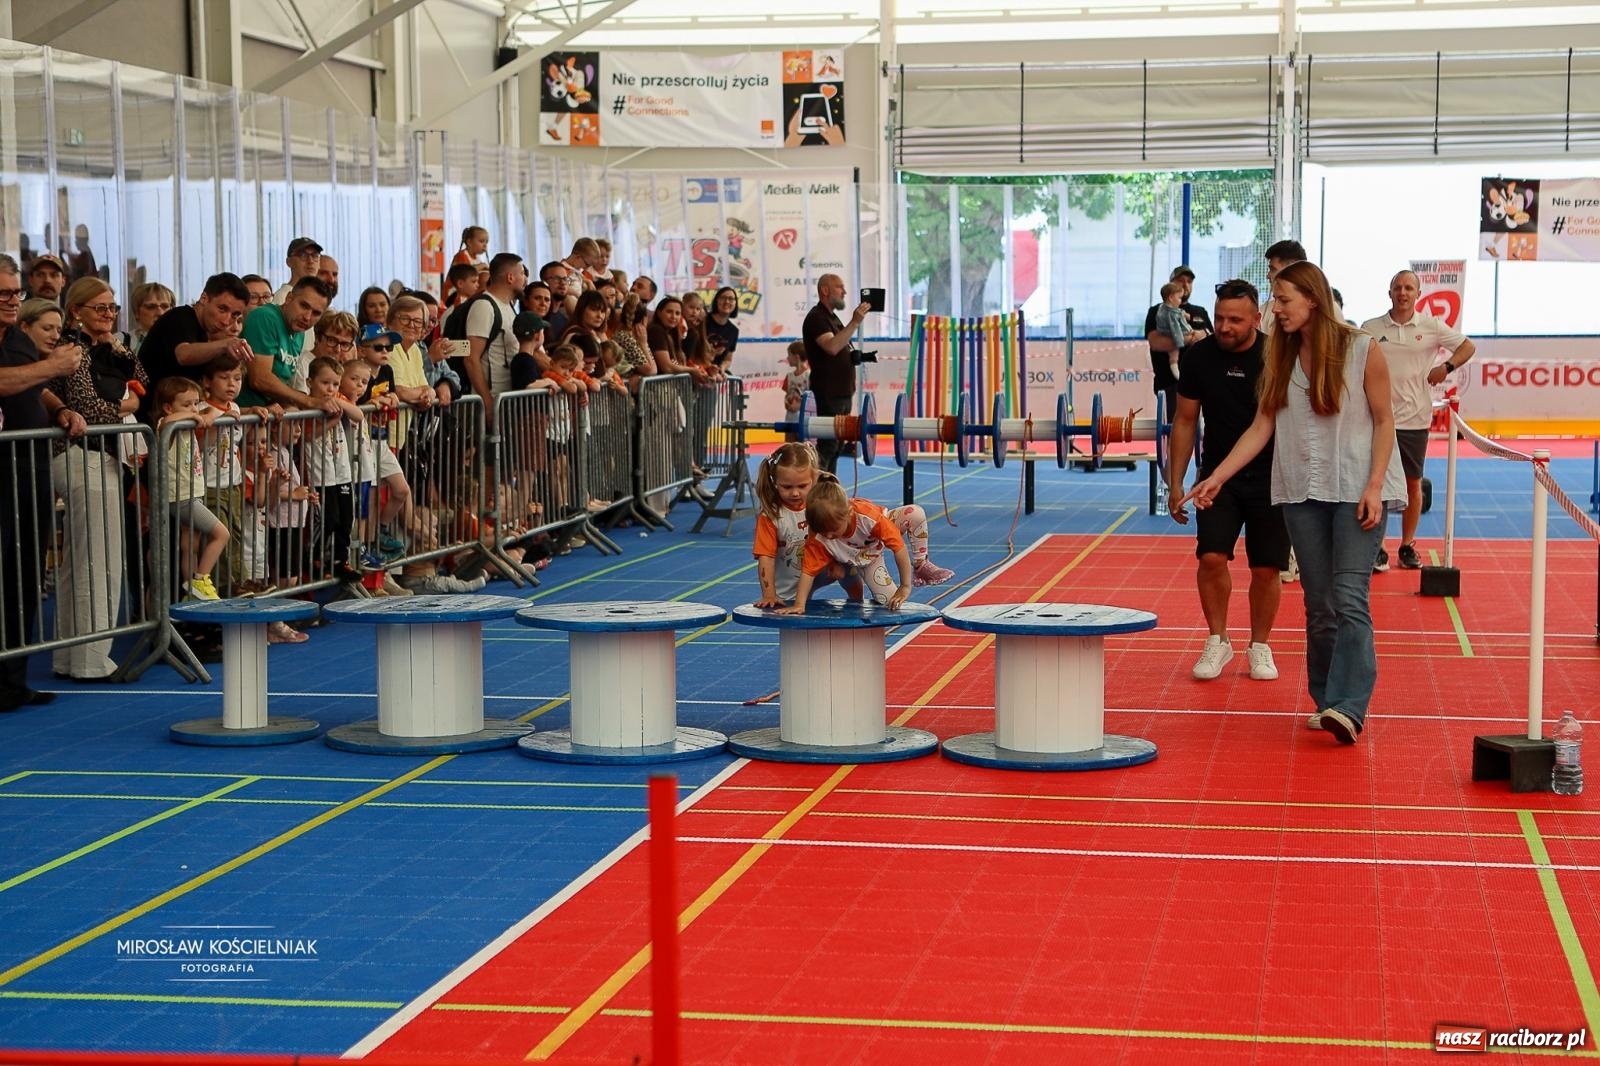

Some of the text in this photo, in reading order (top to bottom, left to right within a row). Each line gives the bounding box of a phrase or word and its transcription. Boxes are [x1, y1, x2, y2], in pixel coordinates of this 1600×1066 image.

[612, 73, 769, 90] Nie przescrolluj życia
[627, 96, 674, 105] For Good
[627, 107, 690, 117] Connections
[1552, 197, 1600, 209] Nie prze
[1568, 216, 1583, 225] For
